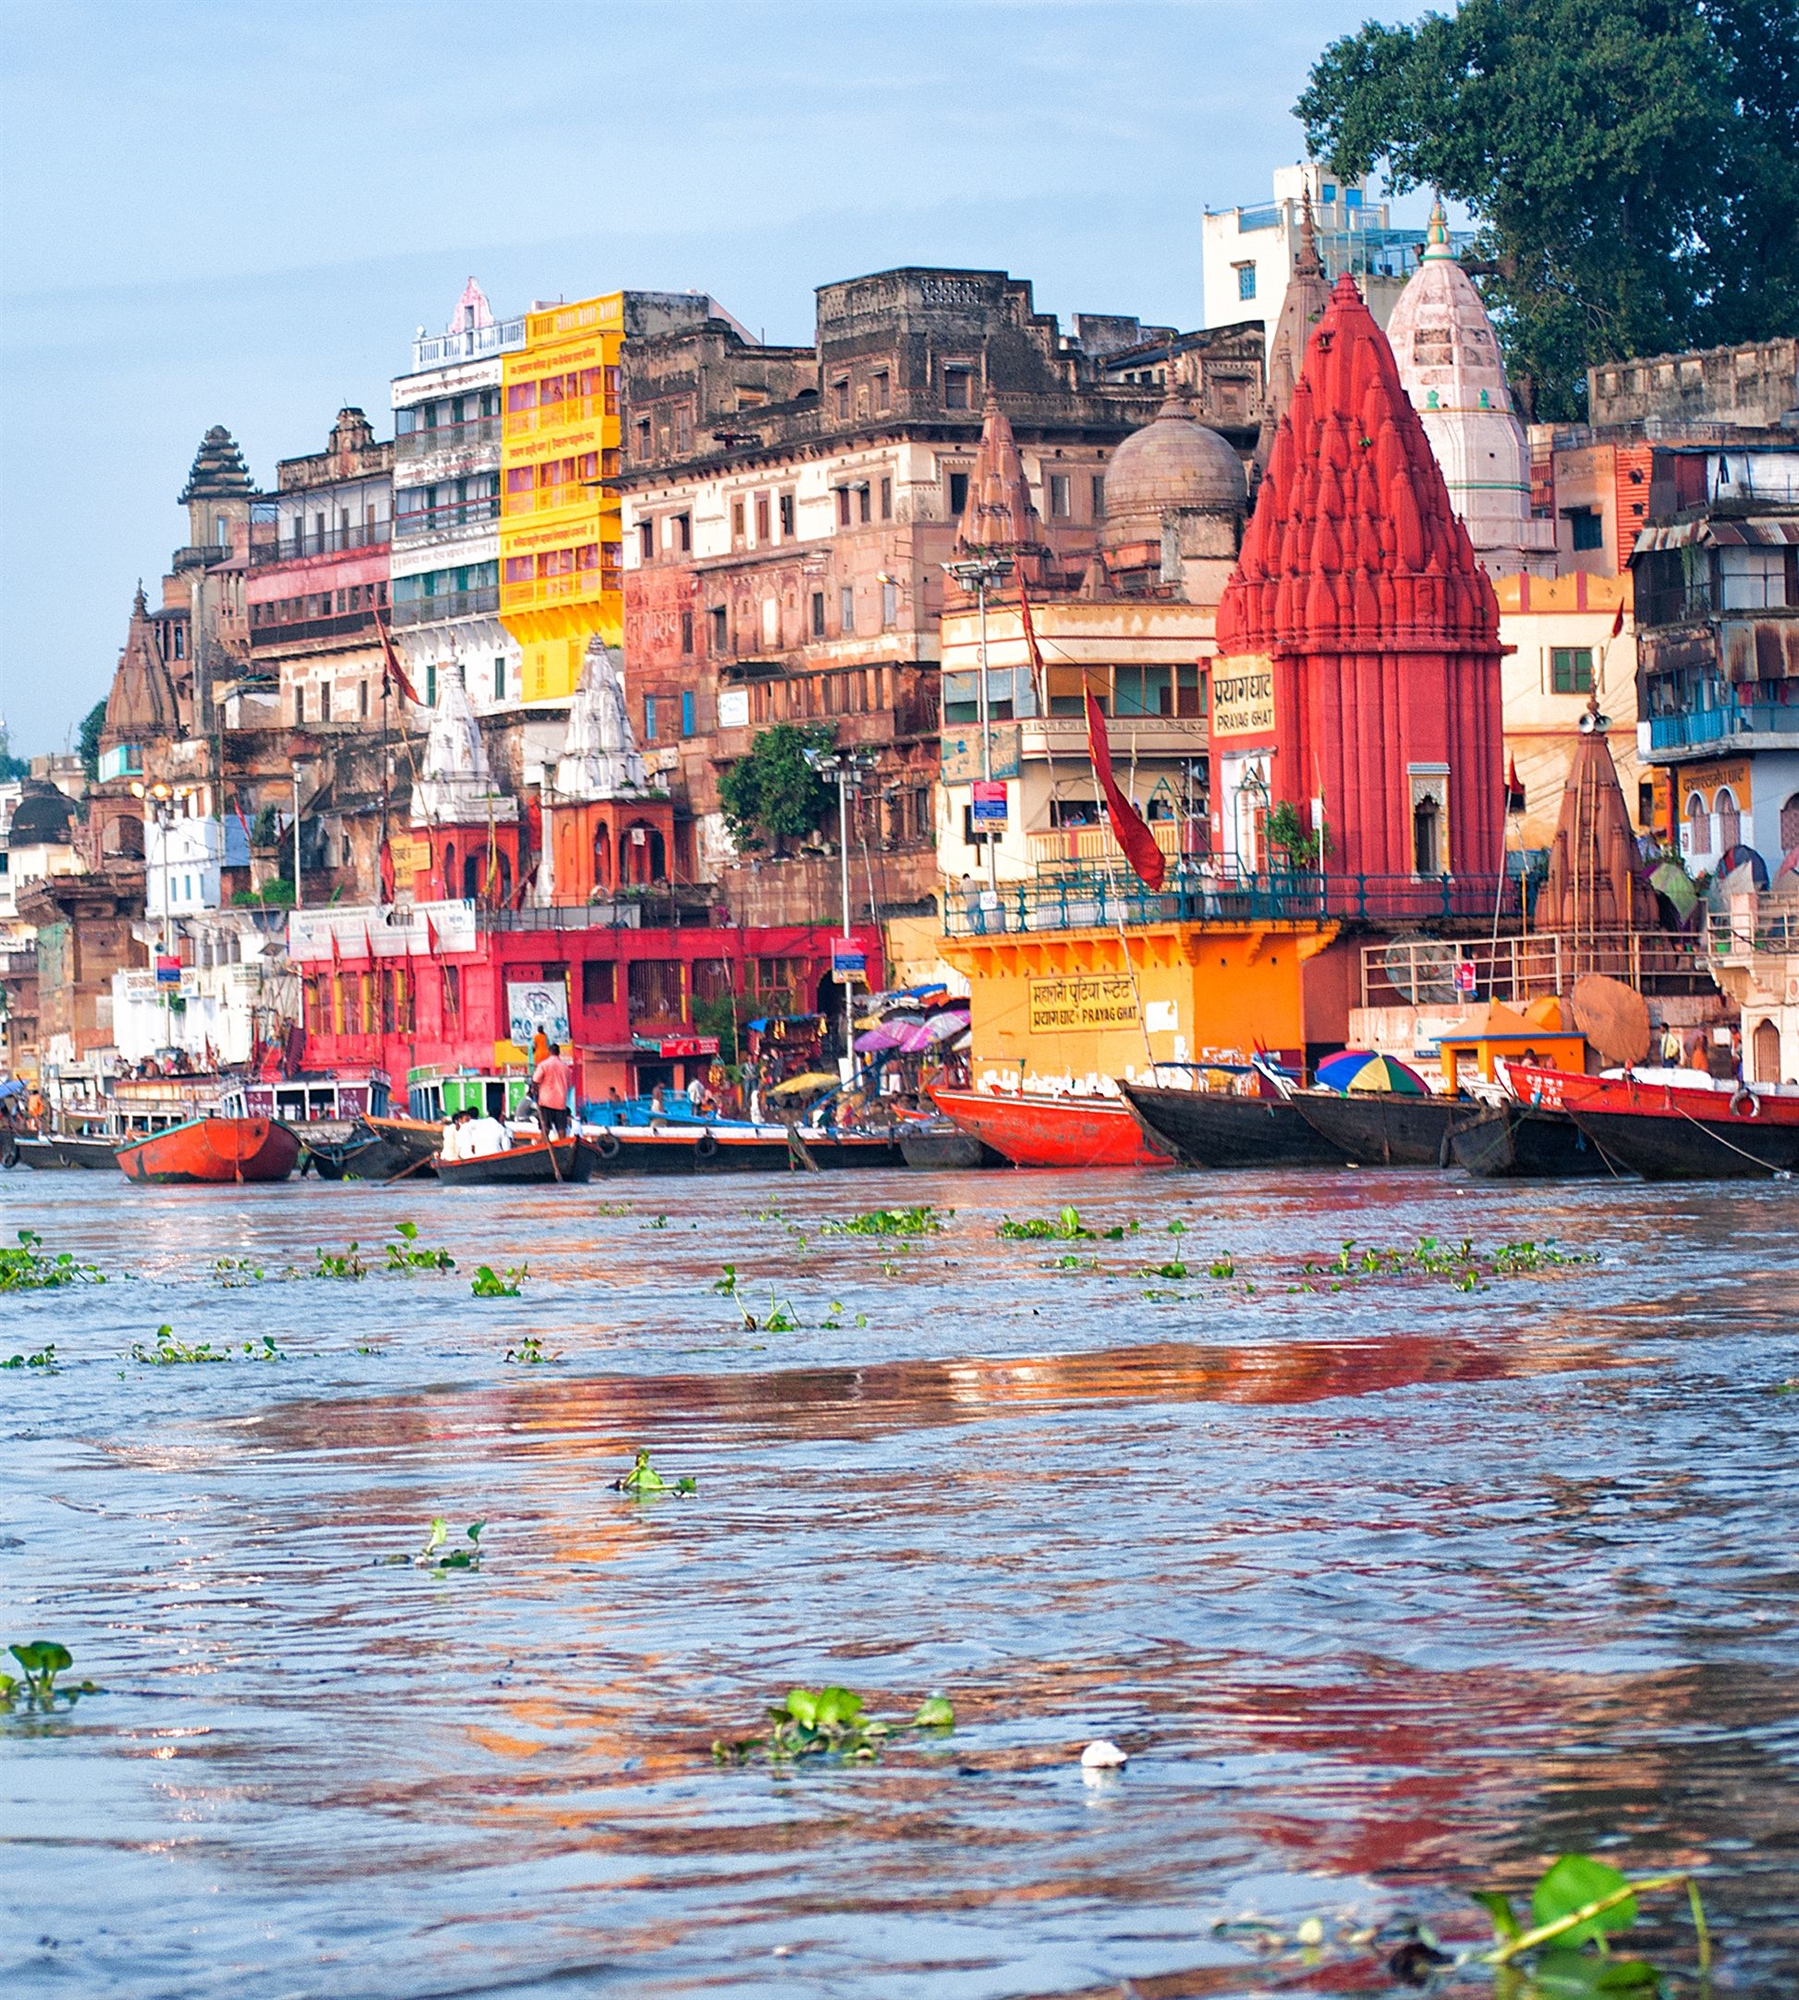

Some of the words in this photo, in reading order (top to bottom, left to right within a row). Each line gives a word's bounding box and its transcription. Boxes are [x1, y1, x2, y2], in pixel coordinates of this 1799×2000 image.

[1216, 711, 1249, 731] PRAYAG
[1251, 708, 1273, 726] GHAT
[1081, 1006, 1116, 1023] PRAYAG
[1116, 1005, 1138, 1020] GHAT
